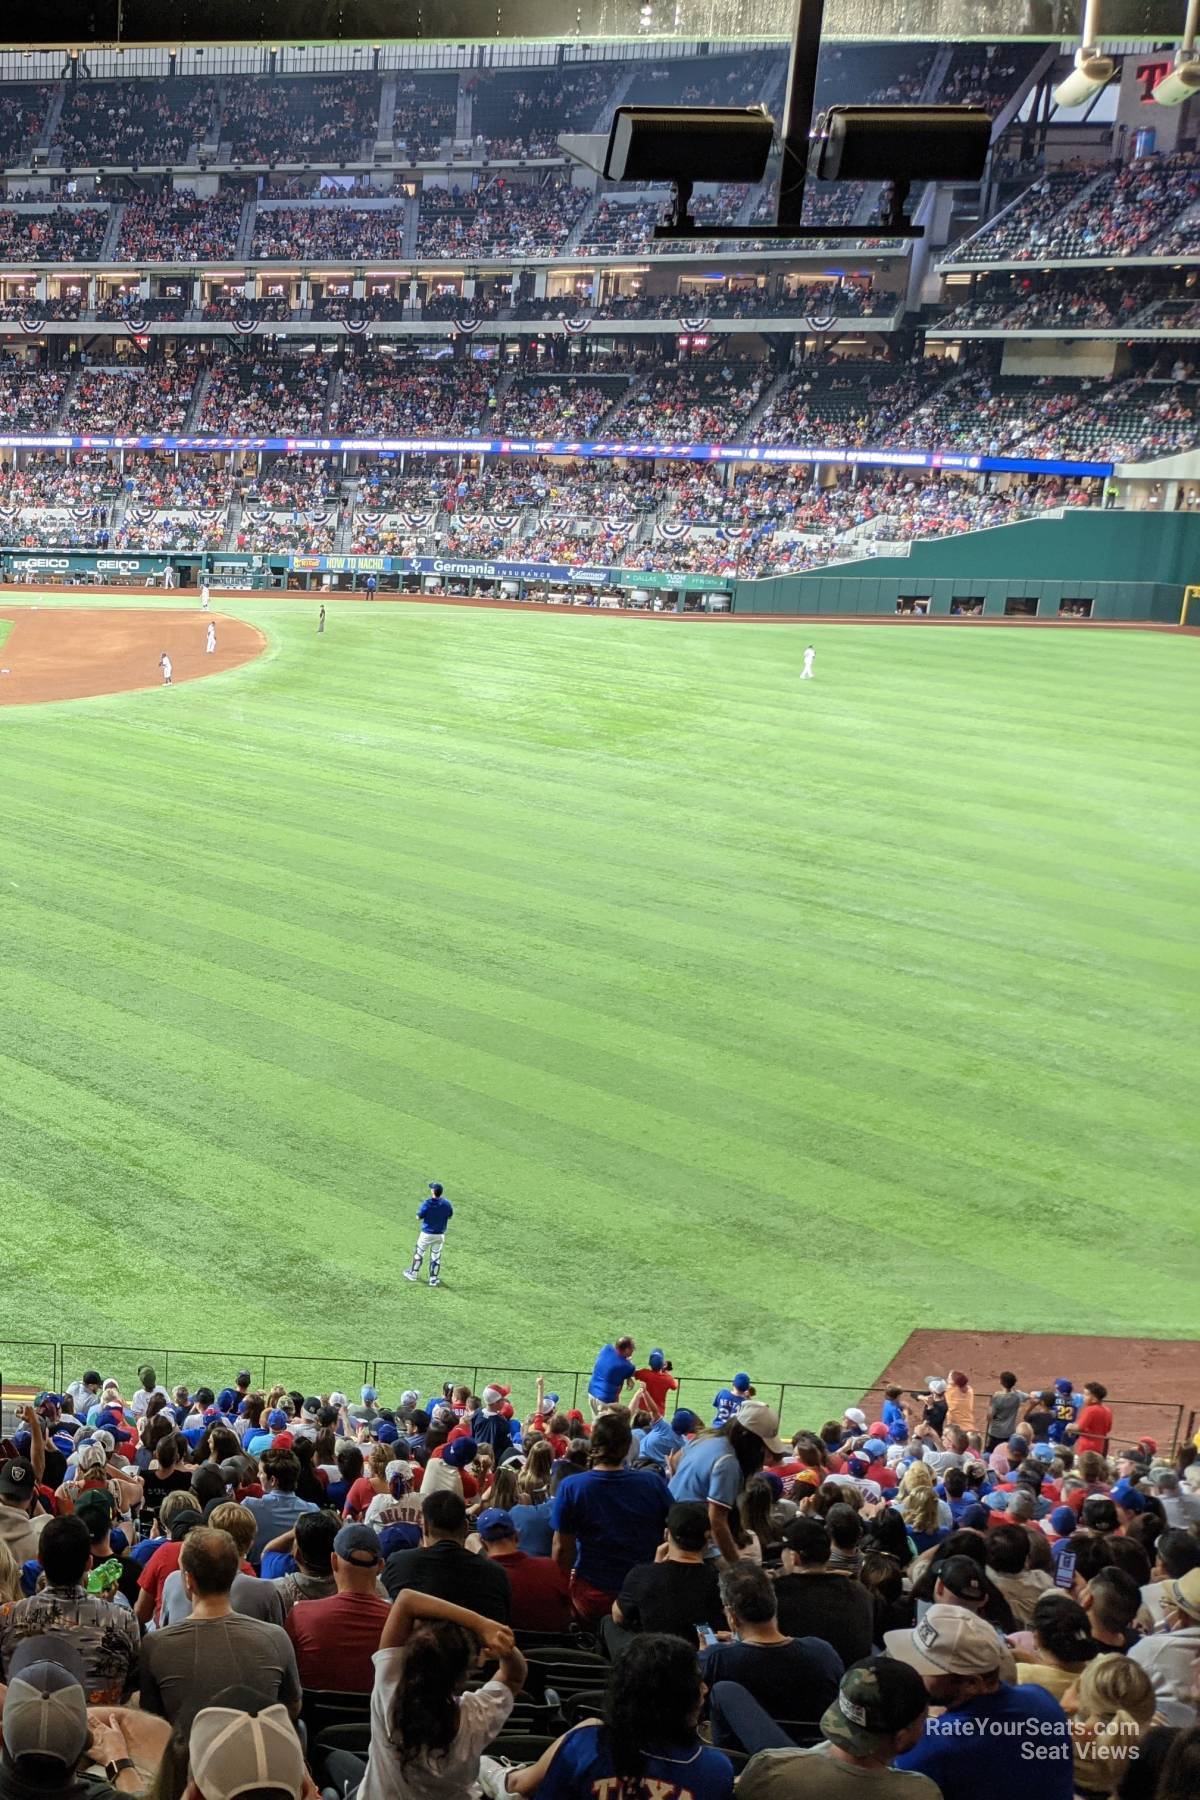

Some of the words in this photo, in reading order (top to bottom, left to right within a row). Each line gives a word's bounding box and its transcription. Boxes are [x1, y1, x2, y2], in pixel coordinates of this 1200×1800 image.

[28, 558, 70, 569] GEICO
[97, 559, 140, 570] GEICO
[326, 556, 345, 569] HOW
[347, 556, 357, 569] TO
[433, 560, 495, 575] Germania
[497, 569, 551, 578] INSURANCE
[1057, 1405, 1073, 1420] 22
